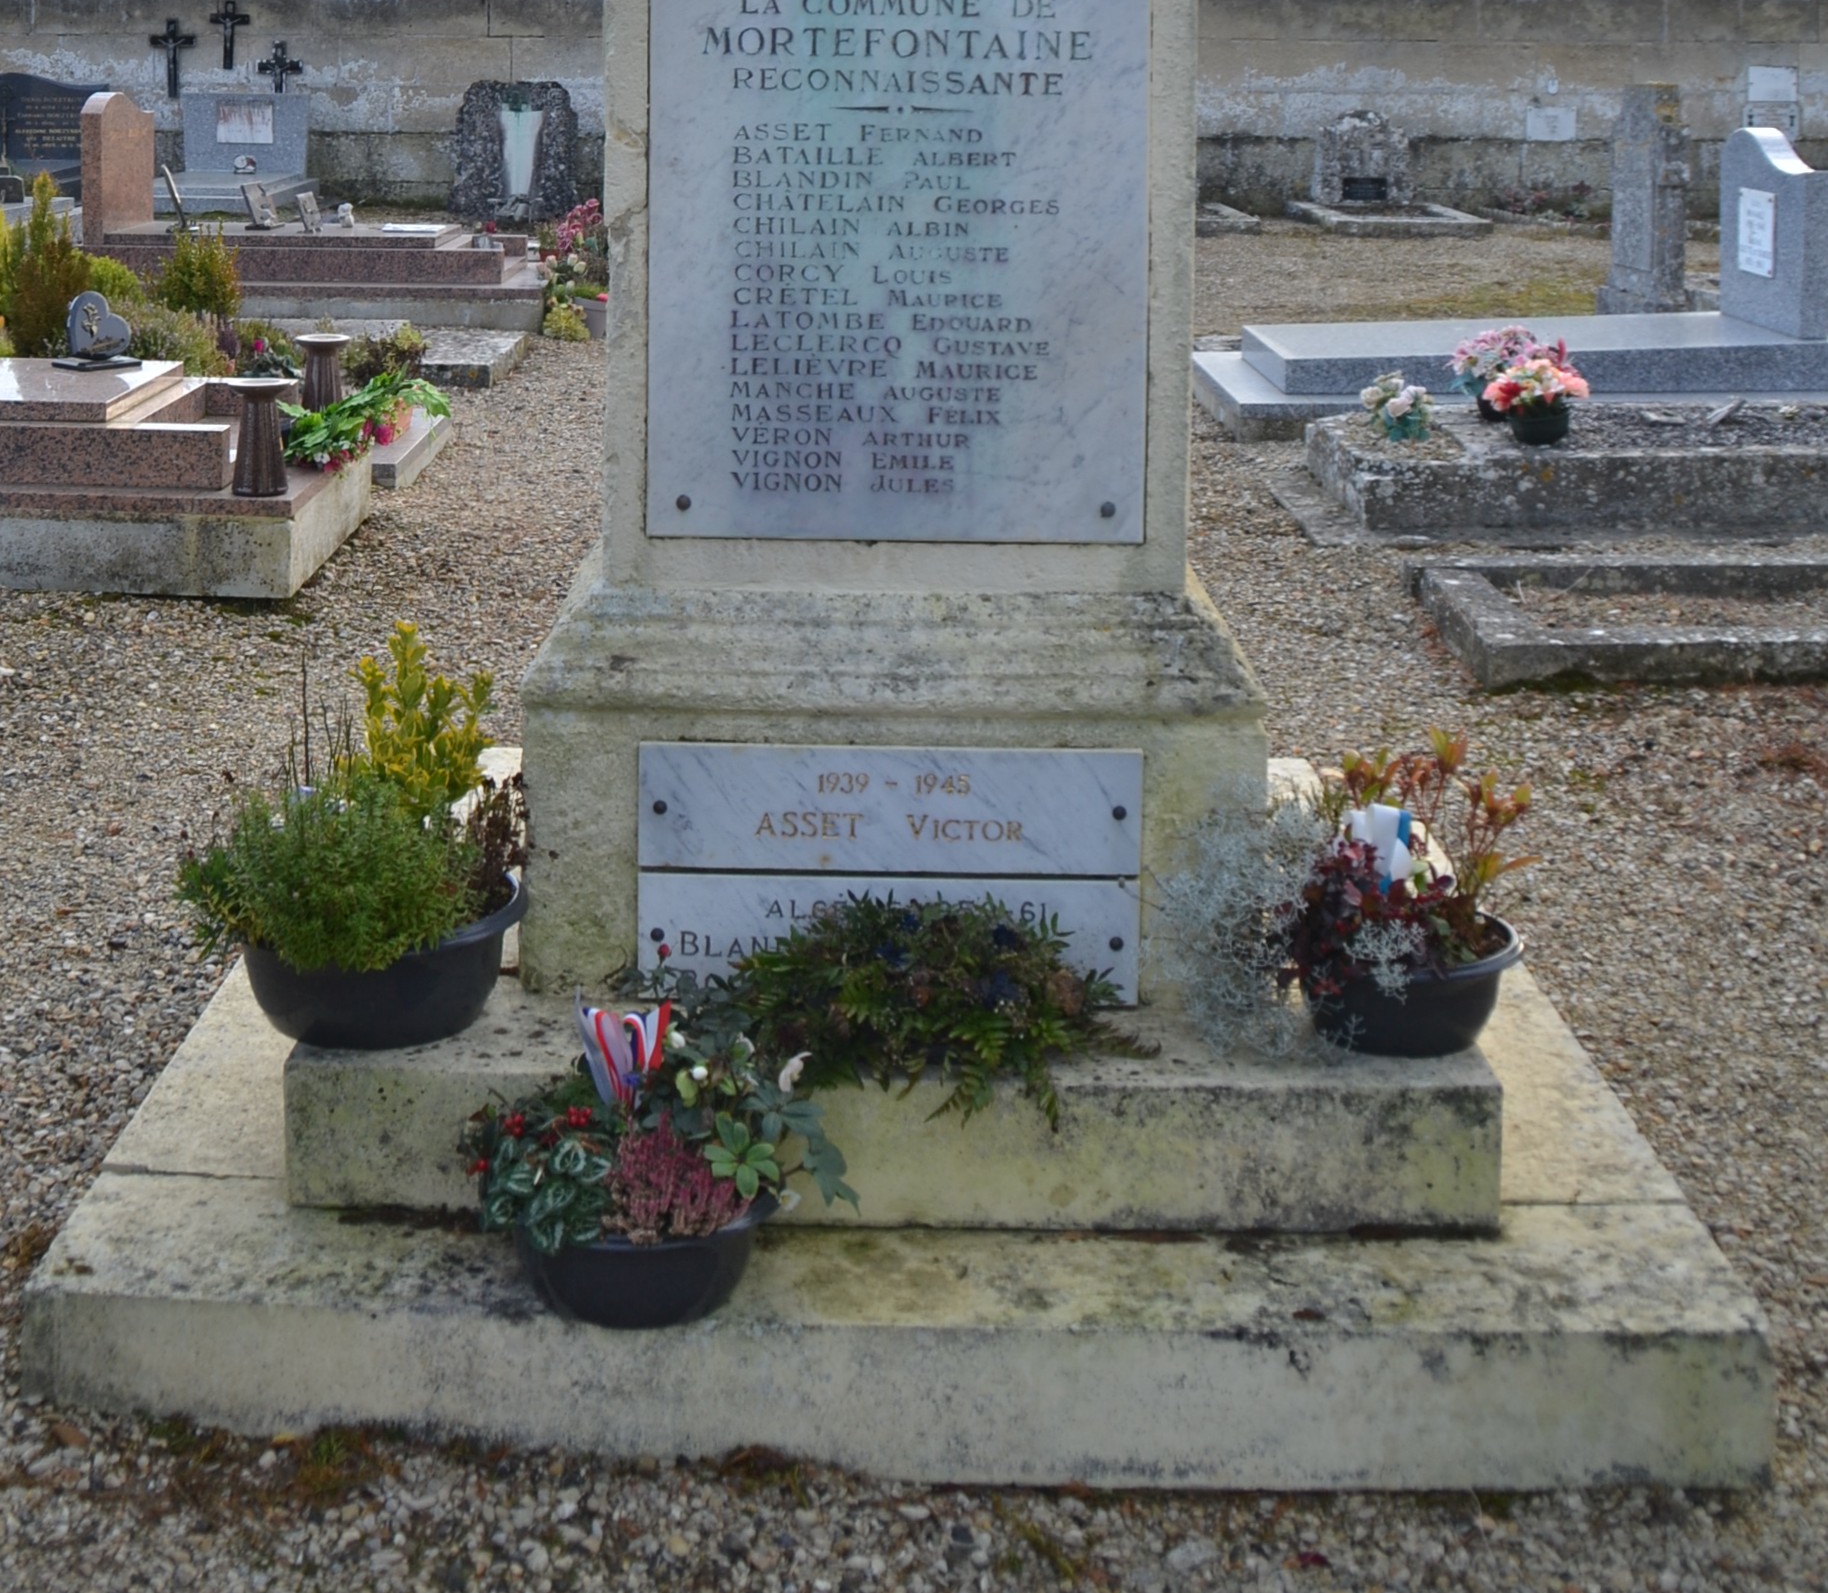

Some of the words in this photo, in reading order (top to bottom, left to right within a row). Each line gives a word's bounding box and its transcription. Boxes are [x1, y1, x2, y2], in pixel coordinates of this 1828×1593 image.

[702, 27, 1093, 61] MORTEFONTAINE
[733, 68, 1063, 95] RECONNAISSANTE
[734, 124, 832, 141] ASSET
[860, 125, 982, 143] FERNAND
[733, 147, 883, 165] BATAILLE
[912, 151, 1017, 167] ALBERT
[733, 171, 874, 188] BLANDIN
[905, 173, 970, 190] PAUL
[935, 197, 1060, 215] GEORGES
[734, 217, 860, 235] CHILAIN
[887, 221, 968, 237] ALBIN
[734, 242, 860, 258] CHILAIN
[889, 244, 1009, 263] AUGUSTE
[734, 265, 844, 282] CORCY
[873, 267, 952, 284] LOUIS
[734, 283, 858, 306] CRÉTEL
[888, 290, 1002, 308] MAURICE
[730, 311, 885, 330] LATOMBE
[912, 315, 1031, 332] EDOUARD
[730, 335, 902, 356] LECLERCQ
[934, 338, 1050, 356] GUSTAVE
[730, 353, 887, 377] LELIÈVRE
[916, 362, 1037, 380] MAURICE
[730, 382, 854, 400] MANCHE
[883, 386, 1000, 402] AUGUSTE
[732, 405, 898, 423] MASSEAUX
[863, 431, 970, 448] ARTHUR
[733, 451, 842, 468] VIGNON
[872, 453, 954, 471] EMILE
[732, 473, 842, 492] VIGNON
[870, 476, 955, 494] JULES
[817, 773, 869, 793] 1939
[915, 773, 971, 794] 1945
[755, 812, 865, 840] ASSET
[906, 815, 1023, 842] VICTOR
